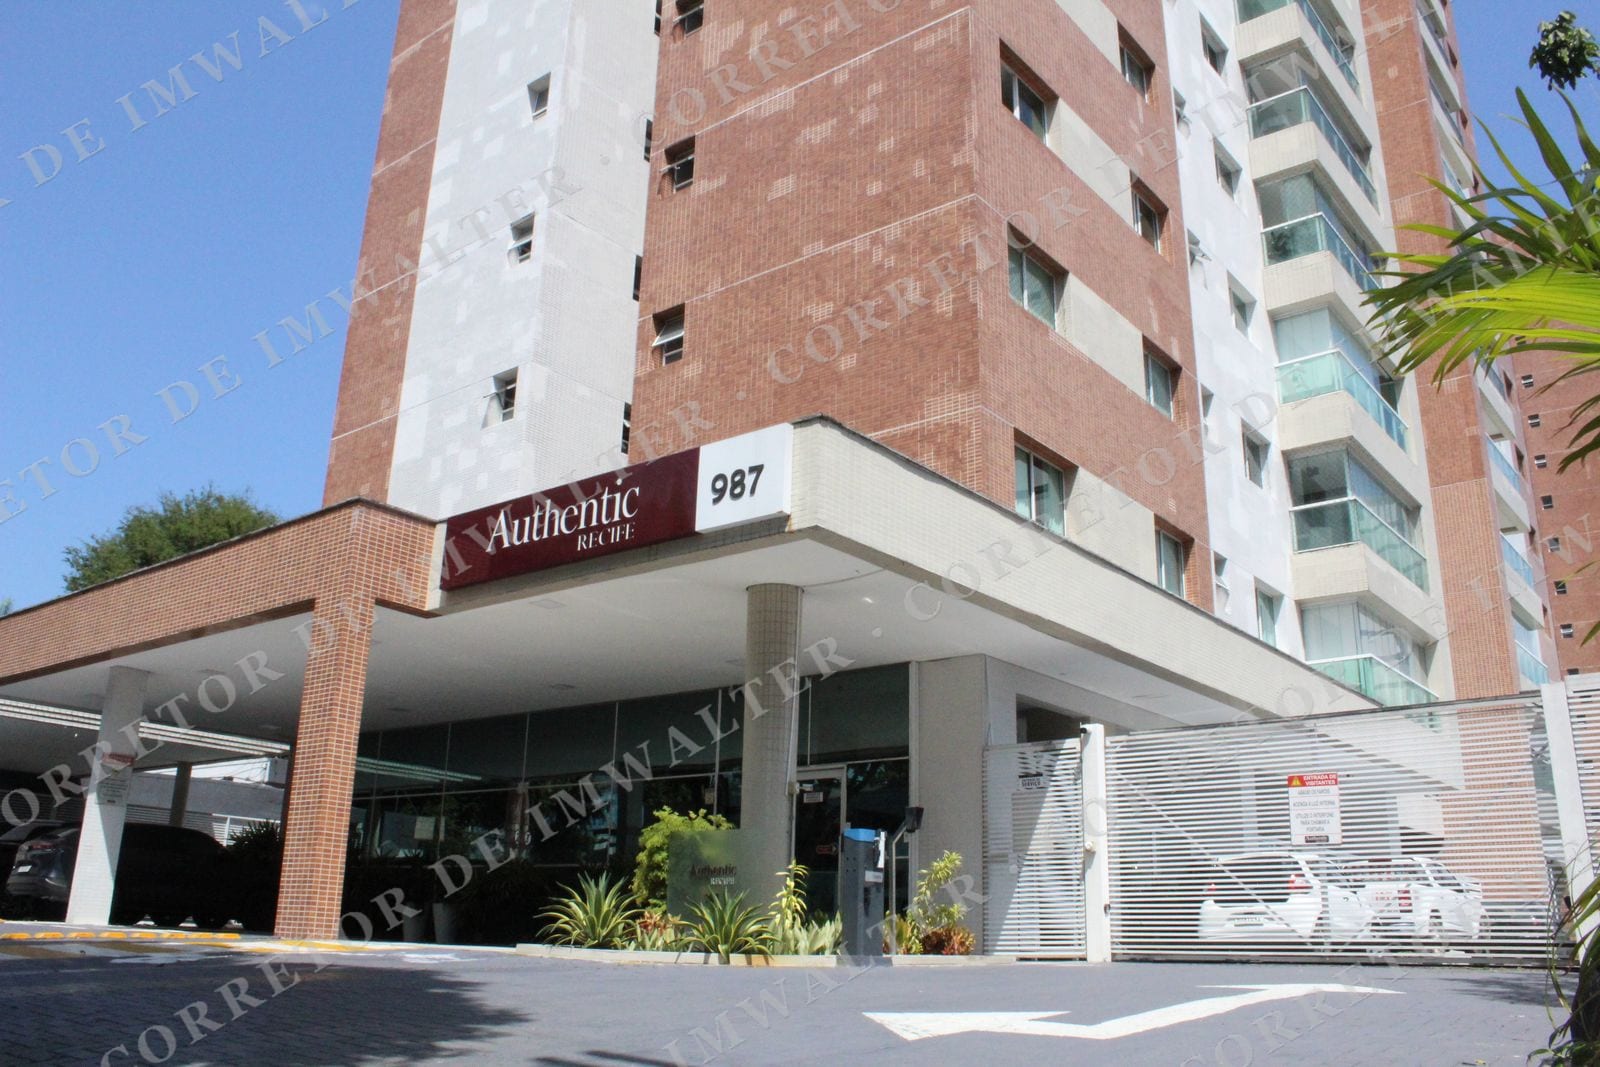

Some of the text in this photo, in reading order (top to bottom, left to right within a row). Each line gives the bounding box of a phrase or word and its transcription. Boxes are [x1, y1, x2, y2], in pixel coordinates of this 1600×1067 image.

[710, 464, 764, 505] 987
[485, 478, 640, 553] Authentic
[577, 523, 635, 551] RECIFE
